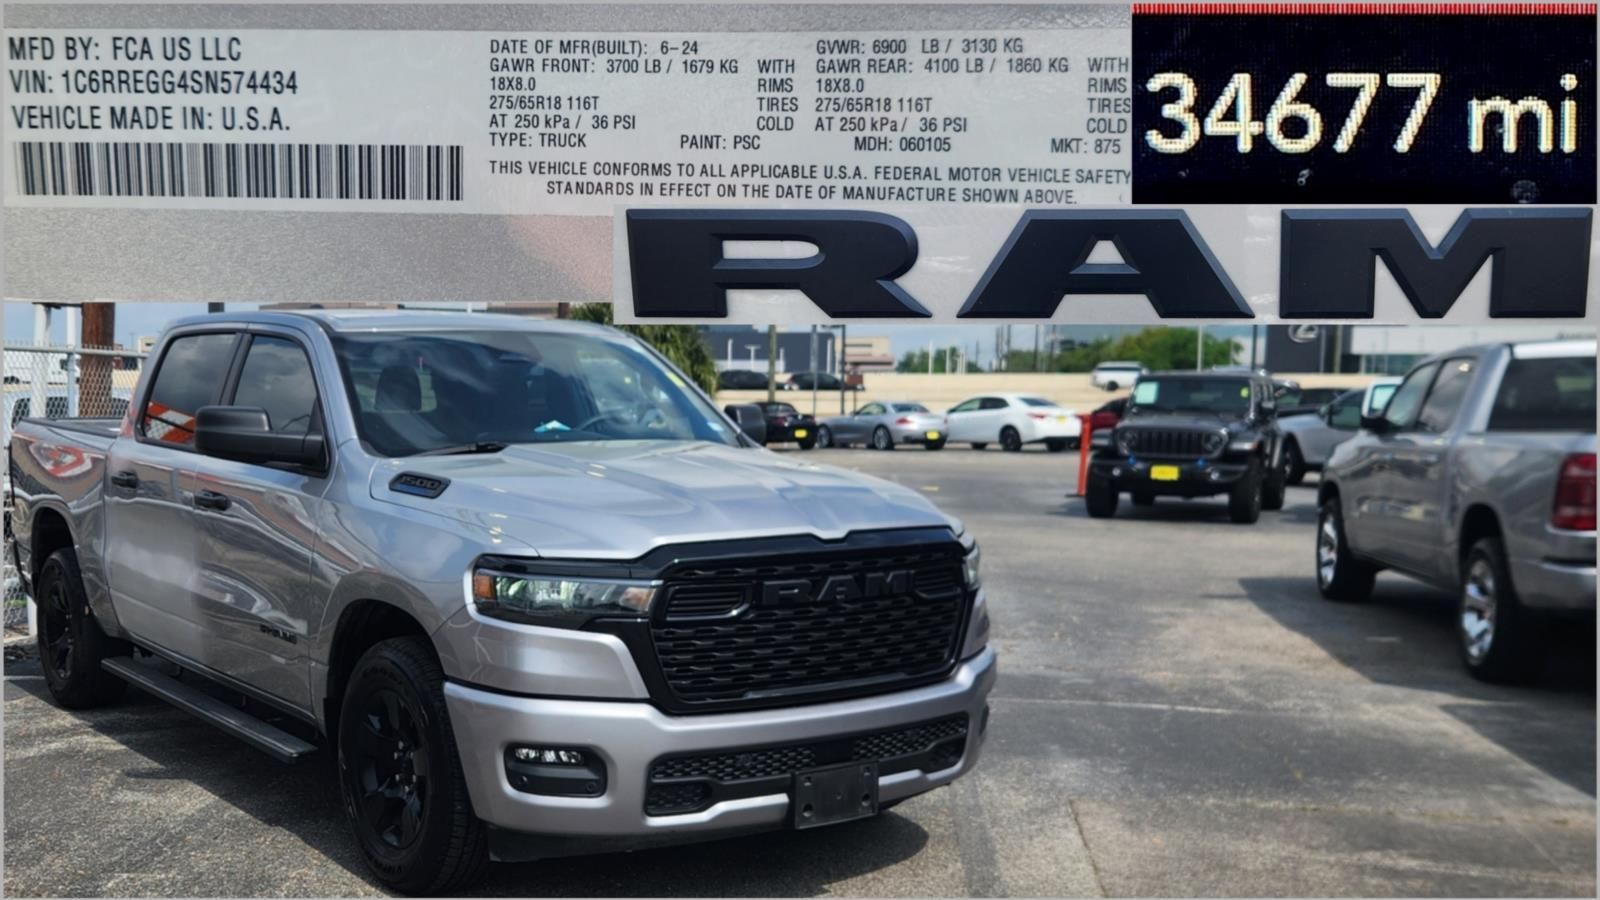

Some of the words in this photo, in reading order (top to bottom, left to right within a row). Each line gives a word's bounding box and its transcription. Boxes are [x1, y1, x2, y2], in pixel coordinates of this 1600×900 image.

[8, 37, 56, 61] MFD
[65, 37, 100, 61] BY:
[112, 37, 154, 61] FCA
[162, 37, 192, 61] US
[201, 37, 242, 61] LLC
[489, 40, 529, 54] DATE
[534, 40, 553, 54] OF
[559, 40, 648, 58] MFR(BUILT):
[660, 40, 699, 56] 6-24
[816, 40, 866, 55] GVWR:
[872, 39, 907, 54] 6900
[921, 39, 940, 53] LB
[961, 38, 998, 53] 3130
[1003, 38, 1024, 53] KG
[489, 58, 535, 73] GAWR
[542, 58, 596, 74] FRONT:
[606, 58, 639, 74] 3700
[644, 58, 662, 74] LB
[682, 59, 715, 74] 1679
[719, 59, 739, 74] KG
[756, 59, 796, 74] WITH
[816, 59, 861, 74] GAWR
[866, 58, 914, 74] REAR:
[924, 58, 959, 73] 4100
[965, 58, 984, 73] LB
[1006, 57, 1042, 73] 1860
[1048, 57, 1069, 73] KG
[1087, 57, 1130, 73] WITH
[8, 70, 54, 94] VIN:
[60, 70, 299, 95] 1C6RREGG4SN574434
[489, 77, 537, 92] 18X8.0
[757, 78, 794, 93] RIMS
[816, 78, 865, 94] 18X8.0
[1087, 78, 1128, 94] RIMS
[489, 95, 562, 111] 275/65R18
[567, 95, 600, 111] 116T
[756, 97, 799, 112] TIRES
[814, 97, 892, 113] 275/65R18
[898, 97, 933, 113] 116T
[1087, 97, 1131, 114] TIRES
[11, 106, 102, 130] VEHICLE
[109, 106, 174, 130] MADE
[182, 106, 213, 131] IN:
[221, 106, 291, 131] U.S.A.
[1145, 72, 1441, 153] 34677
[1467, 73, 1578, 153] mi
[489, 114, 509, 129] AT
[514, 114, 540, 129] 250
[544, 114, 570, 130] kPa
[591, 115, 609, 130] 36
[613, 115, 636, 130] PSI
[756, 116, 794, 131] COLD
[814, 117, 836, 132] AT
[839, 117, 866, 132] 250
[870, 117, 898, 133] kPa
[919, 117, 938, 133] 36
[942, 117, 968, 133] PSI
[1086, 118, 1128, 134] COLD
[489, 133, 533, 147] TYPE:
[538, 133, 587, 148] TRUCK
[680, 135, 727, 149] PAINT:
[732, 135, 761, 150] PSC
[853, 136, 893, 152] MDH:
[899, 136, 952, 152] 060105
[1050, 138, 1088, 154] MKT:
[1093, 138, 1121, 154] 875
[489, 160, 523, 175] THIS
[528, 161, 588, 176] VEHICLE
[593, 161, 672, 177] CONFORMS
[677, 163, 695, 177] TO
[699, 163, 726, 178] ALL
[730, 163, 818, 179] APPLICABLE
[823, 165, 868, 180] U.S.A.
[874, 165, 942, 181] FEDERAL
[948, 167, 1001, 182] MOTOR
[1007, 167, 1071, 183] VEHICLE
[1075, 168, 1131, 185] SAFETY
[546, 180, 635, 196] STANDARDS
[639, 182, 654, 197] IN
[660, 182, 711, 197] EFFECT
[716, 183, 737, 198] ON
[742, 184, 769, 198] THE
[775, 184, 814, 199] DATE
[818, 185, 837, 199] OF
[842, 185, 957, 202] MANUFACTURE
[962, 187, 1019, 203] SHOWN
[1023, 188, 1078, 205] ABOVE.
[625, 208, 1593, 319] RAM
[401, 475, 441, 489] 1500
[763, 570, 916, 606] RAM
